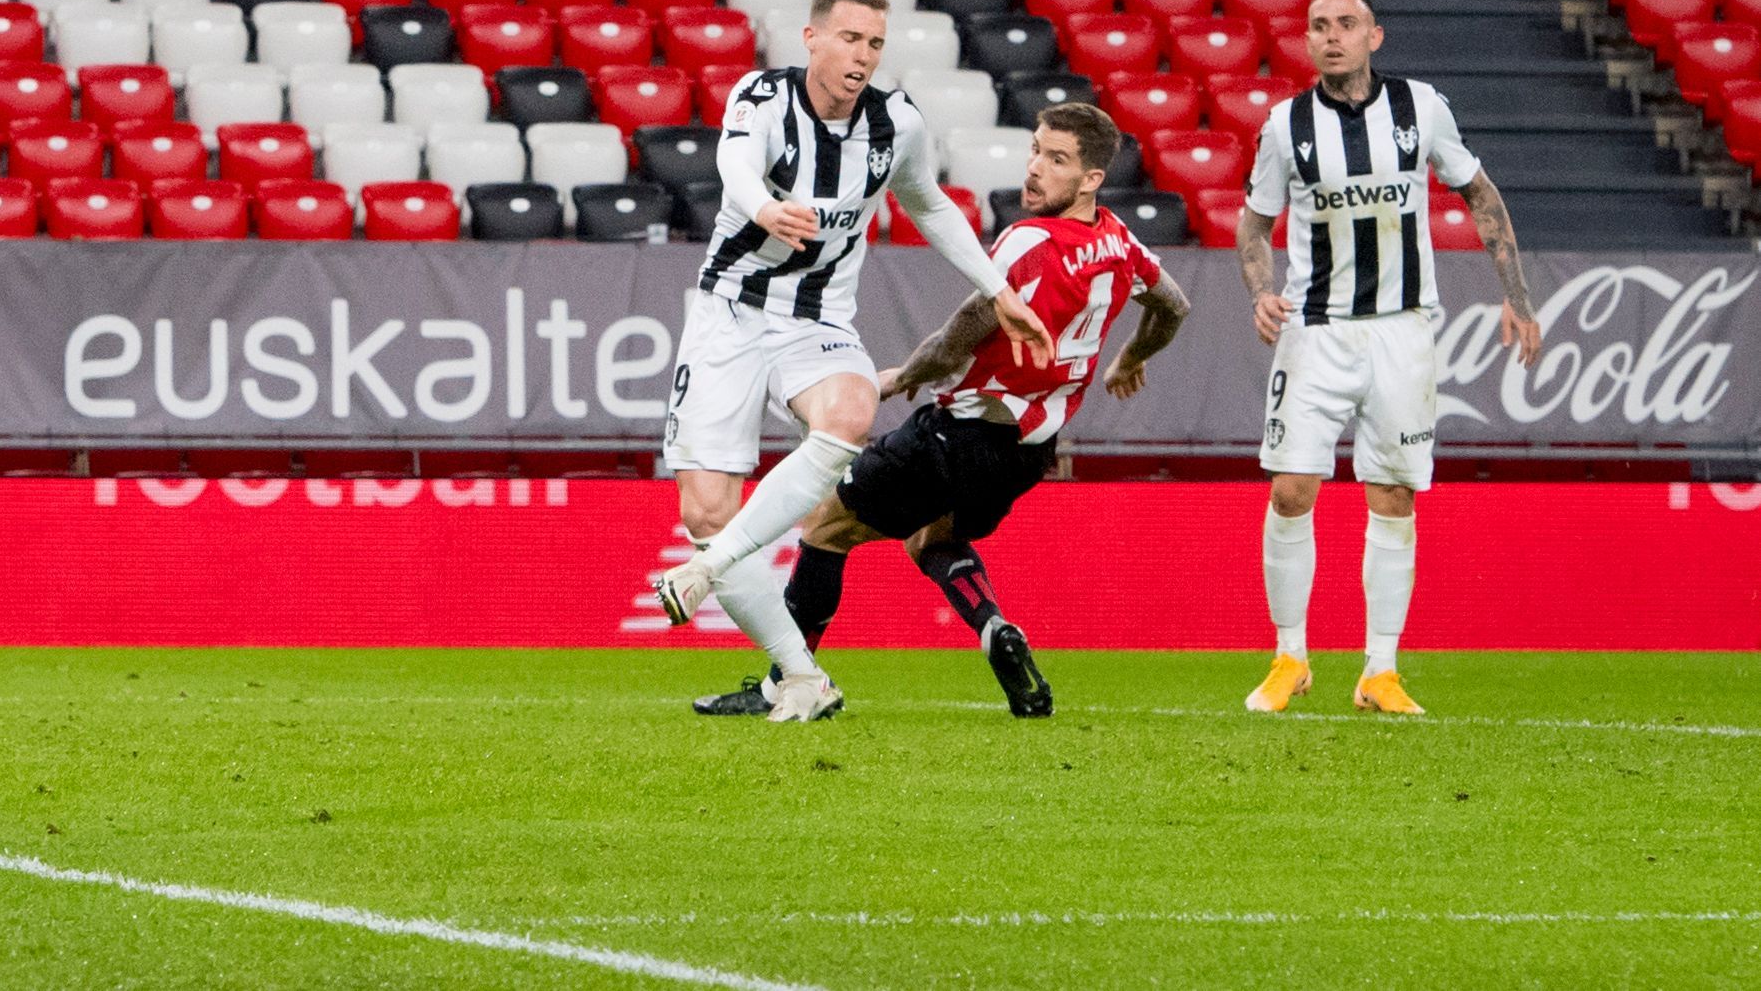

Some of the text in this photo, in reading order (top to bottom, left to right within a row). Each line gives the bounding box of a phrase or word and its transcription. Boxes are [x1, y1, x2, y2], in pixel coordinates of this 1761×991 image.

[1311, 182, 1411, 212] betway
[64, 288, 698, 422] euskalte
[1054, 271, 1115, 380] 4
[1271, 369, 1287, 411] 9
